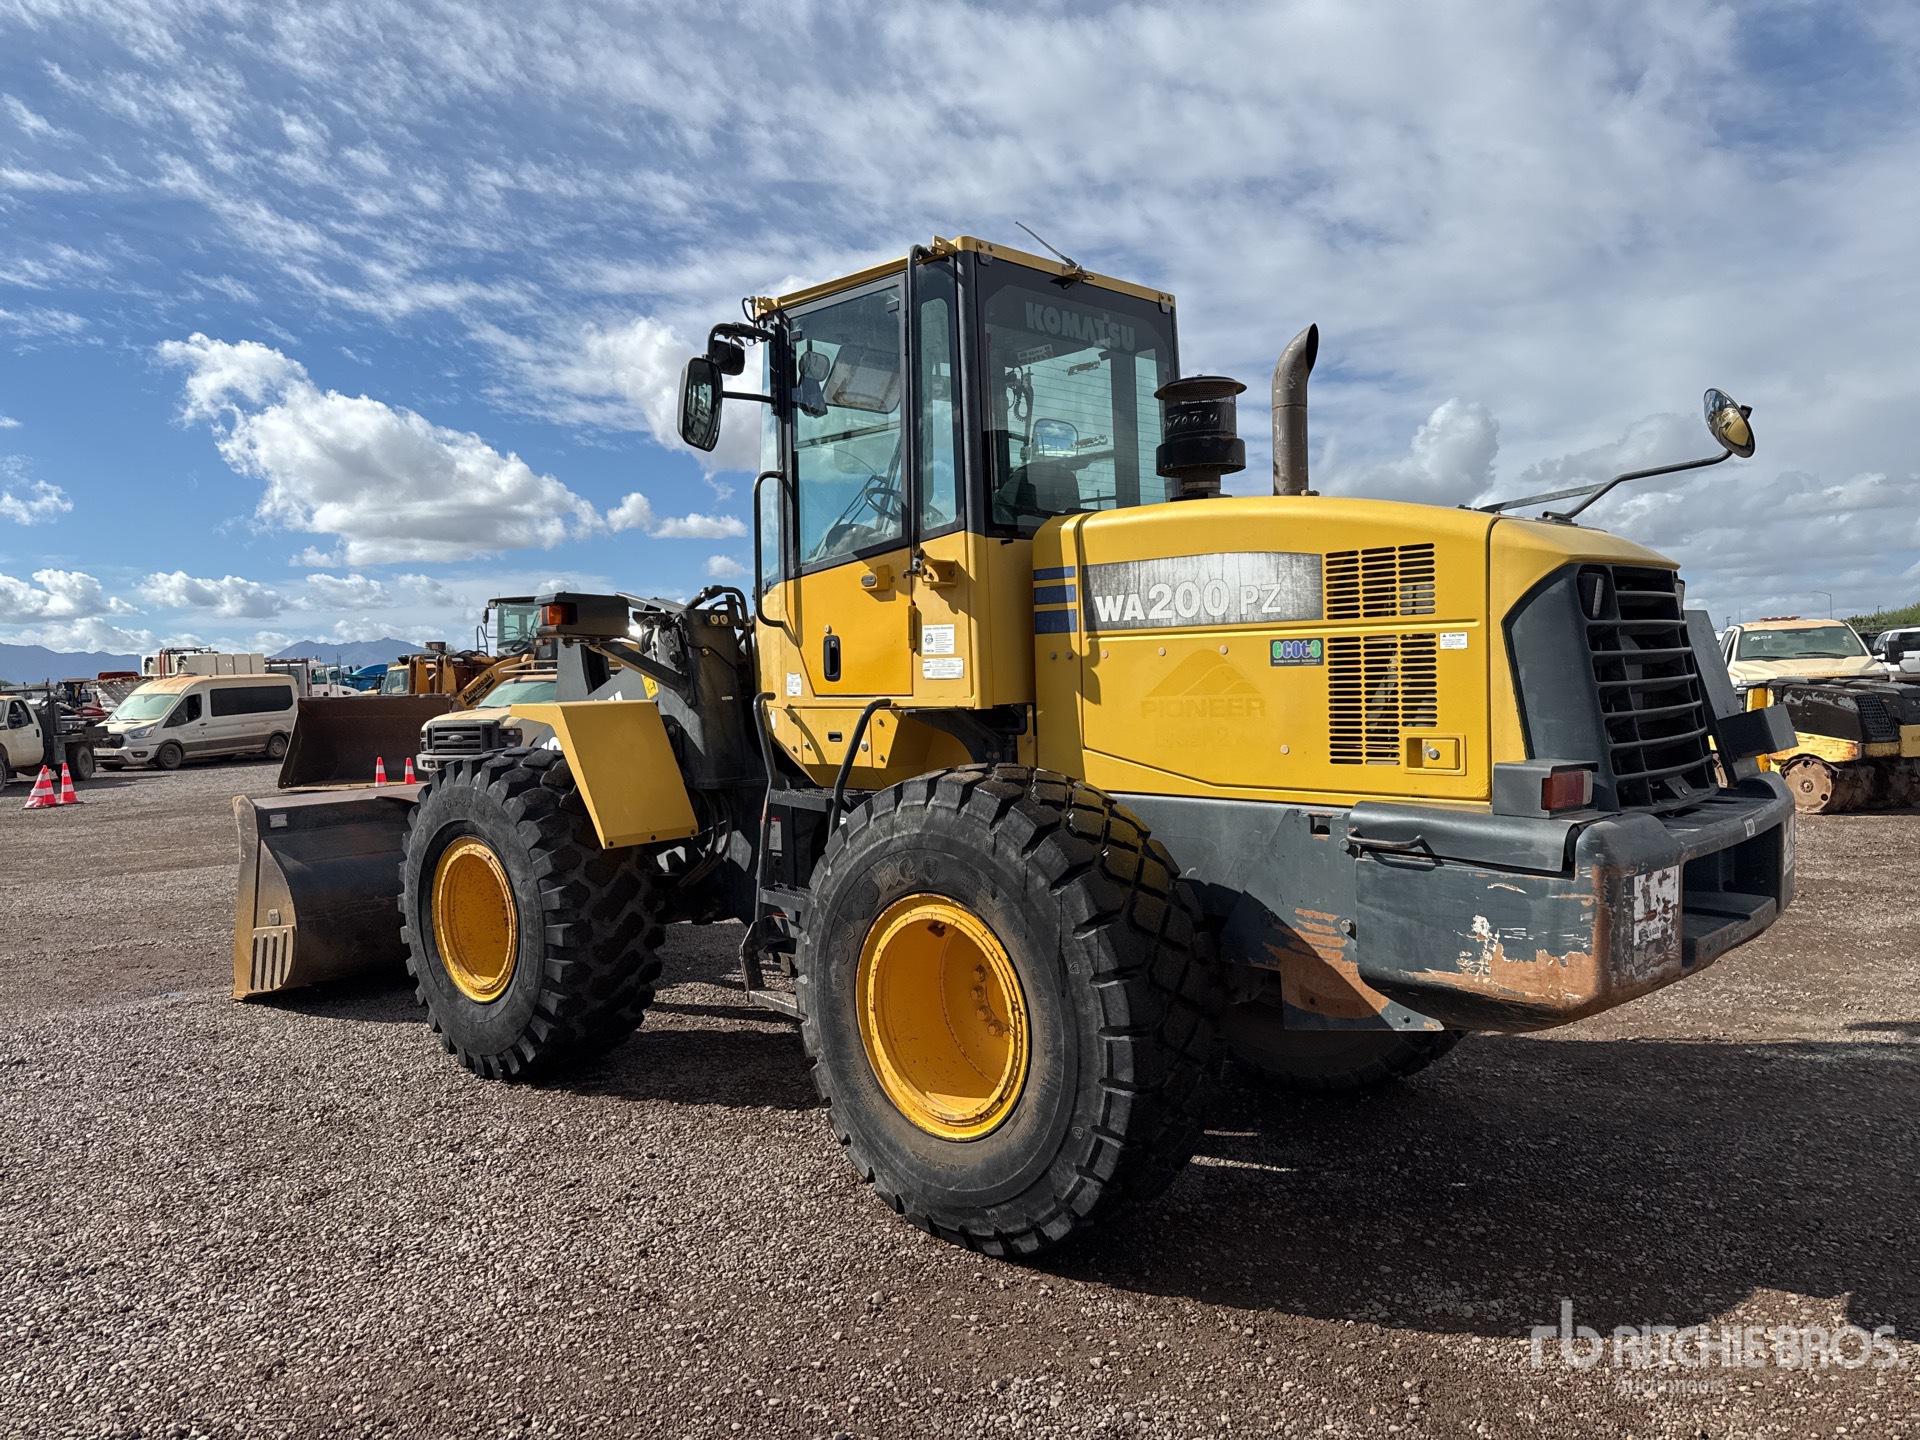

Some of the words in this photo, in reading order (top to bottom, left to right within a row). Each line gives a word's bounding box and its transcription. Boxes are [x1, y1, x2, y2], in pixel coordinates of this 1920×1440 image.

[1025, 301, 1136, 351] KOMATSU
[1095, 578, 1230, 622] WA200
[1239, 583, 1282, 615] PZ
[463, 670, 495, 702] Kawasaki
[1140, 697, 1266, 719] PIONEER
